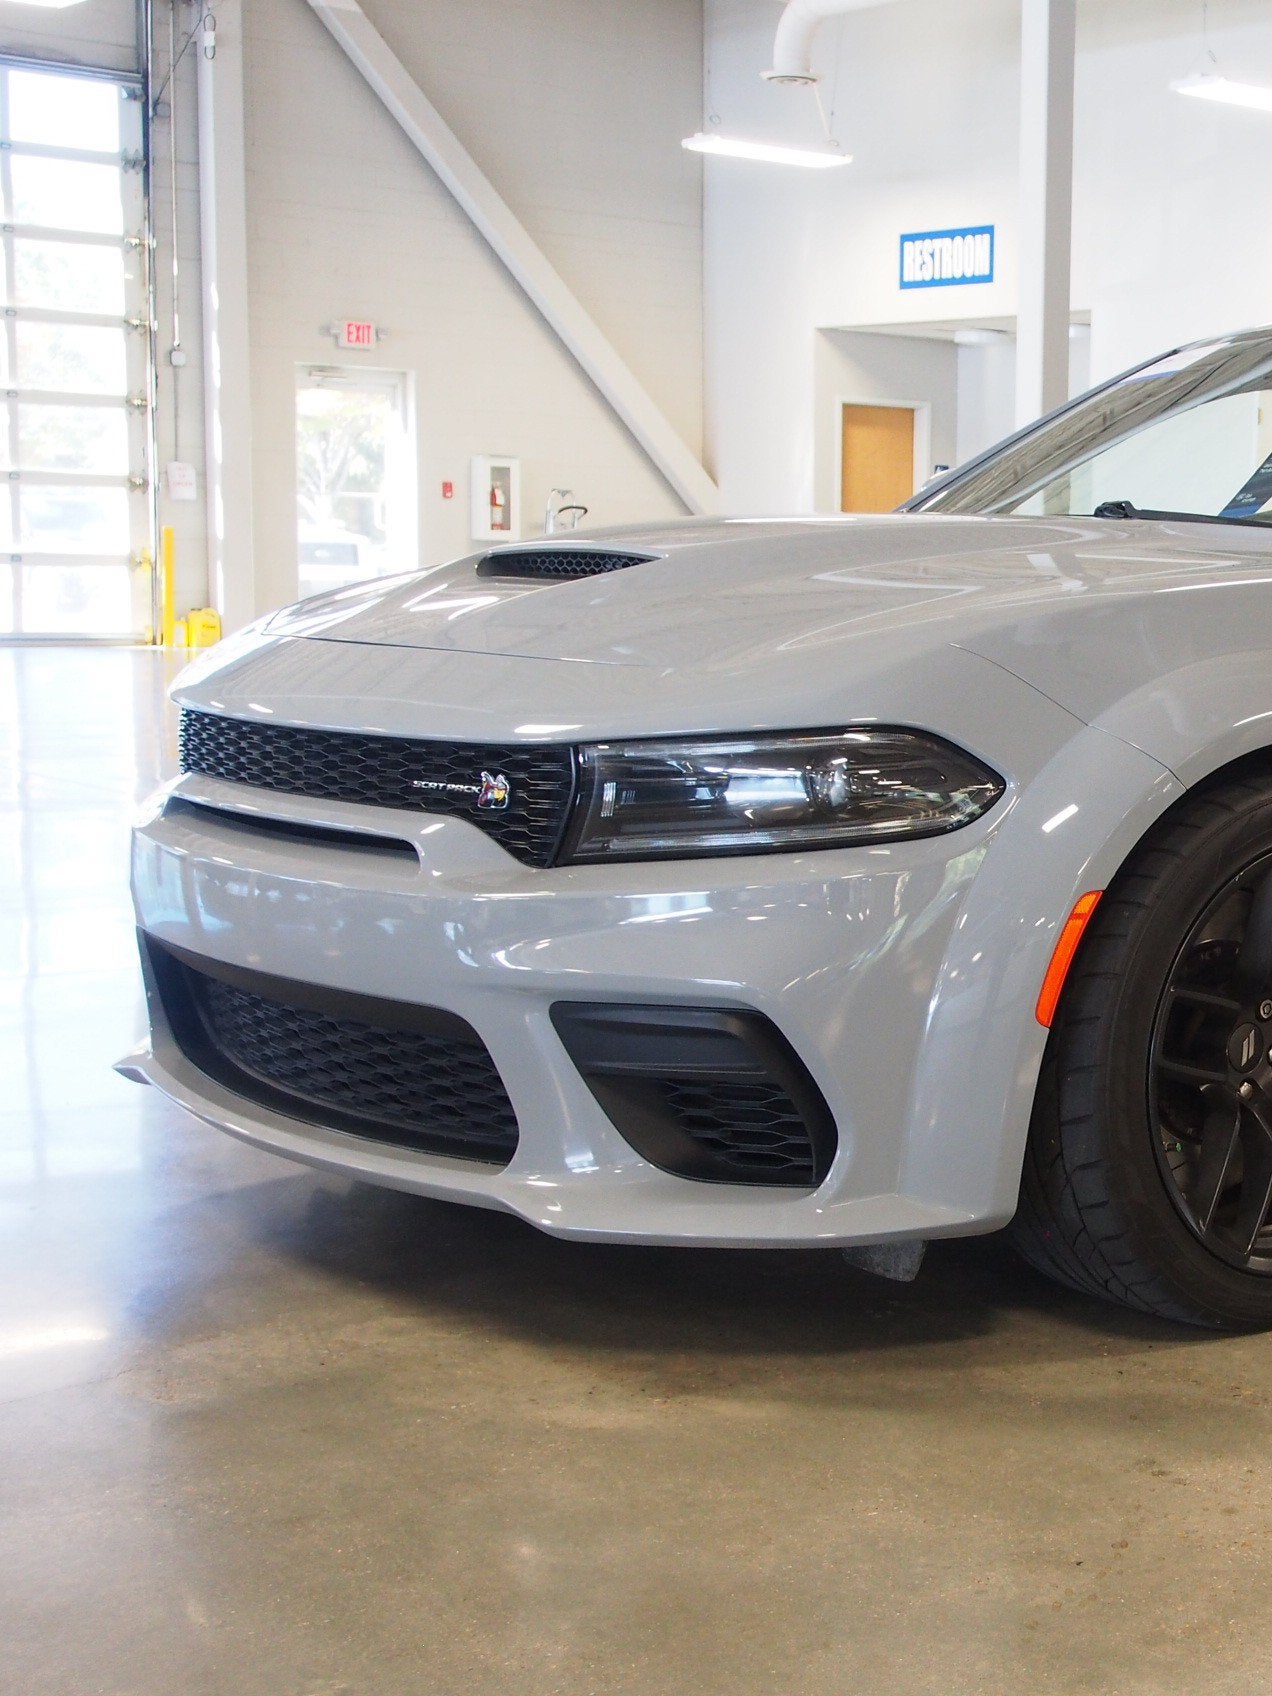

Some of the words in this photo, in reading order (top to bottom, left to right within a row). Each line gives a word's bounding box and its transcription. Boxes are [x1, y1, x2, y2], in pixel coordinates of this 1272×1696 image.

[903, 233, 990, 282] RESTROOM
[346, 322, 372, 344] EXIT
[412, 780, 446, 790] SCAT
[446, 783, 482, 793] PACK
